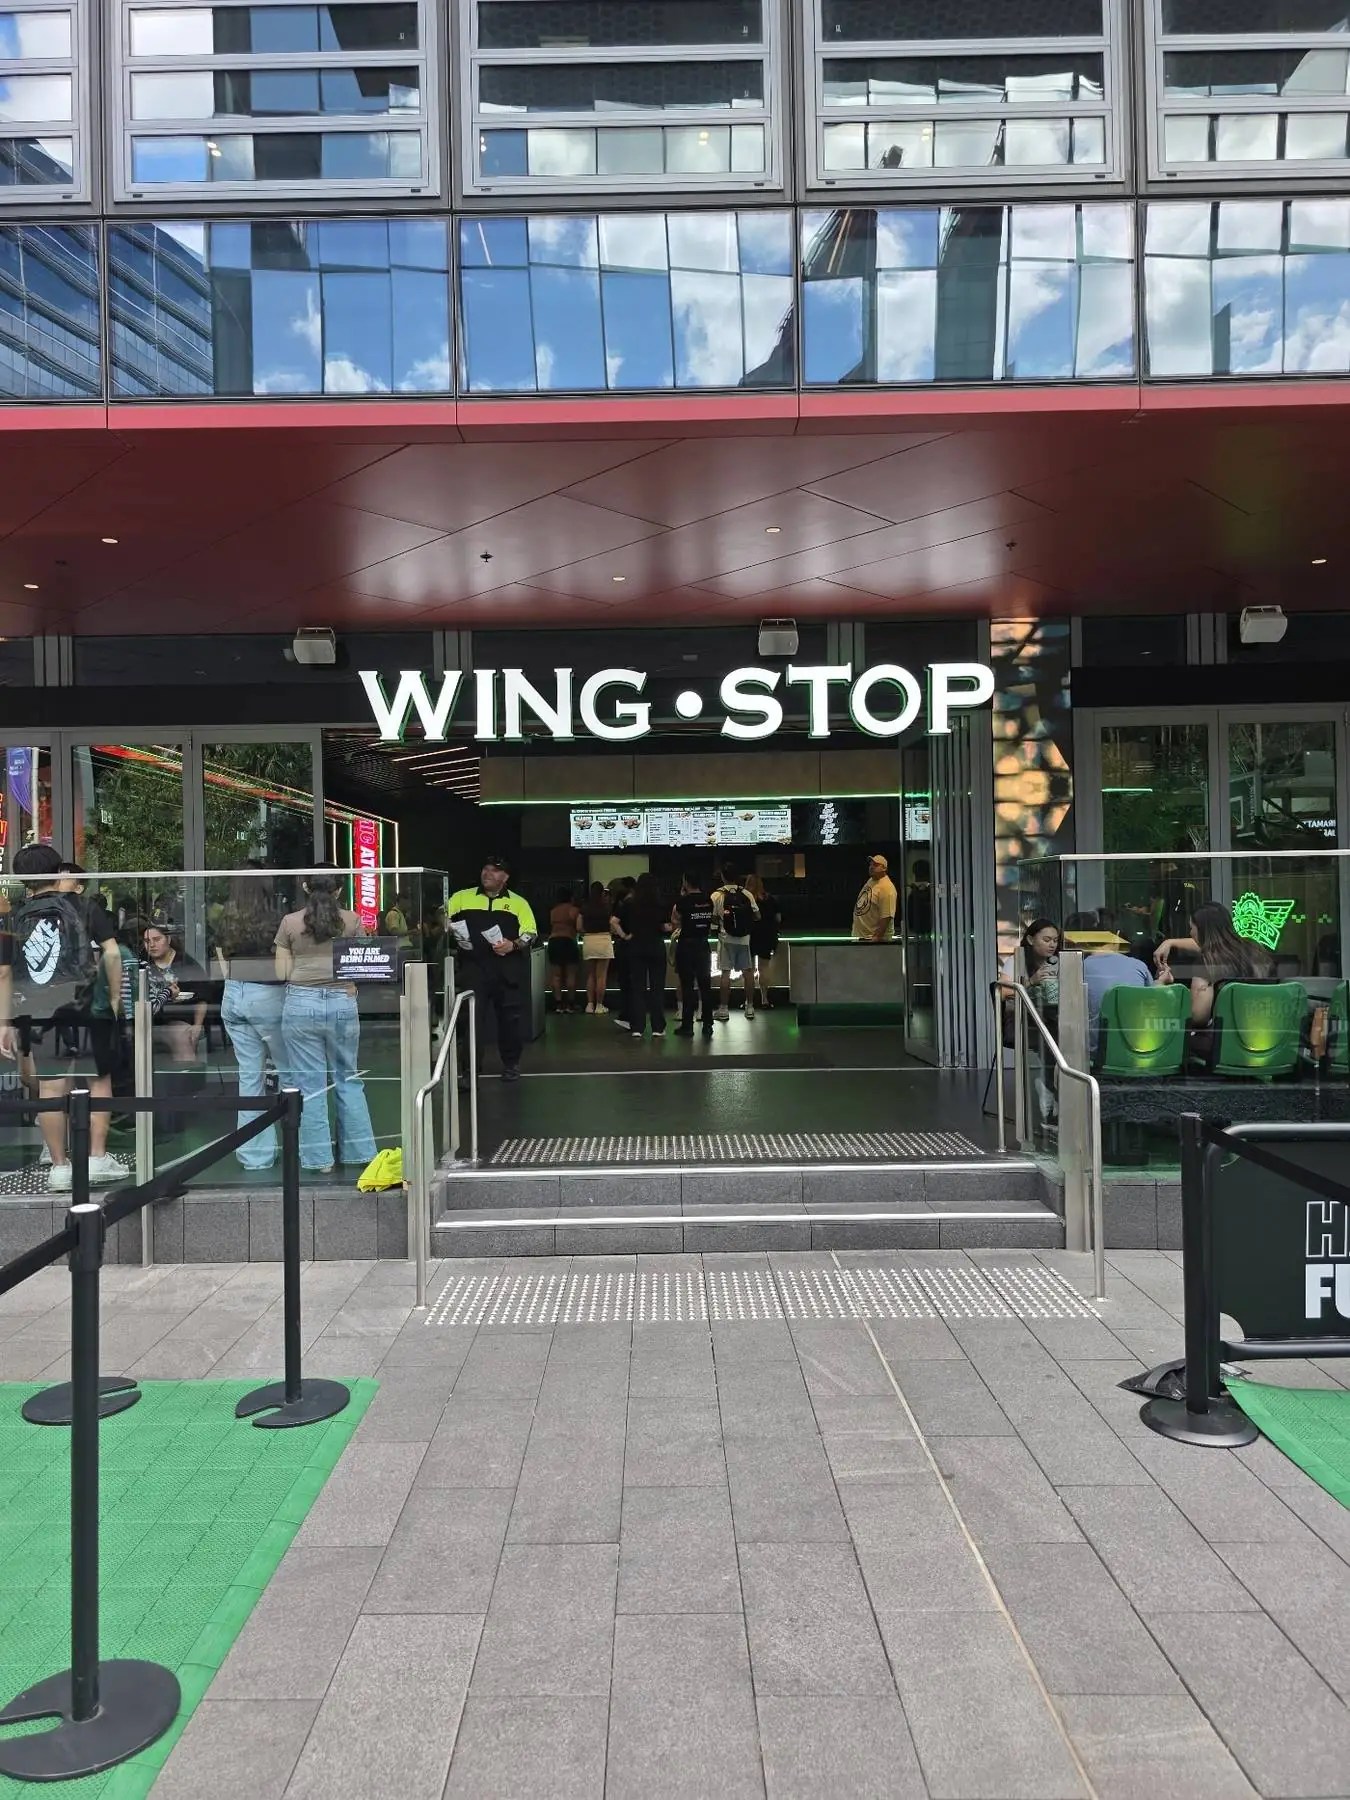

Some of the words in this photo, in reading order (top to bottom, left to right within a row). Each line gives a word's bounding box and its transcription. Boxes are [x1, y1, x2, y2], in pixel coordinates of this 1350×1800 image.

[358, 668, 652, 742] WING
[720, 662, 995, 740] STOP
[340, 955, 363, 964] BEING
[363, 955, 390, 963] FILMED
[348, 947, 365, 955] YOU
[365, 947, 381, 955] ARE
[1305, 1200, 1350, 1258] H
